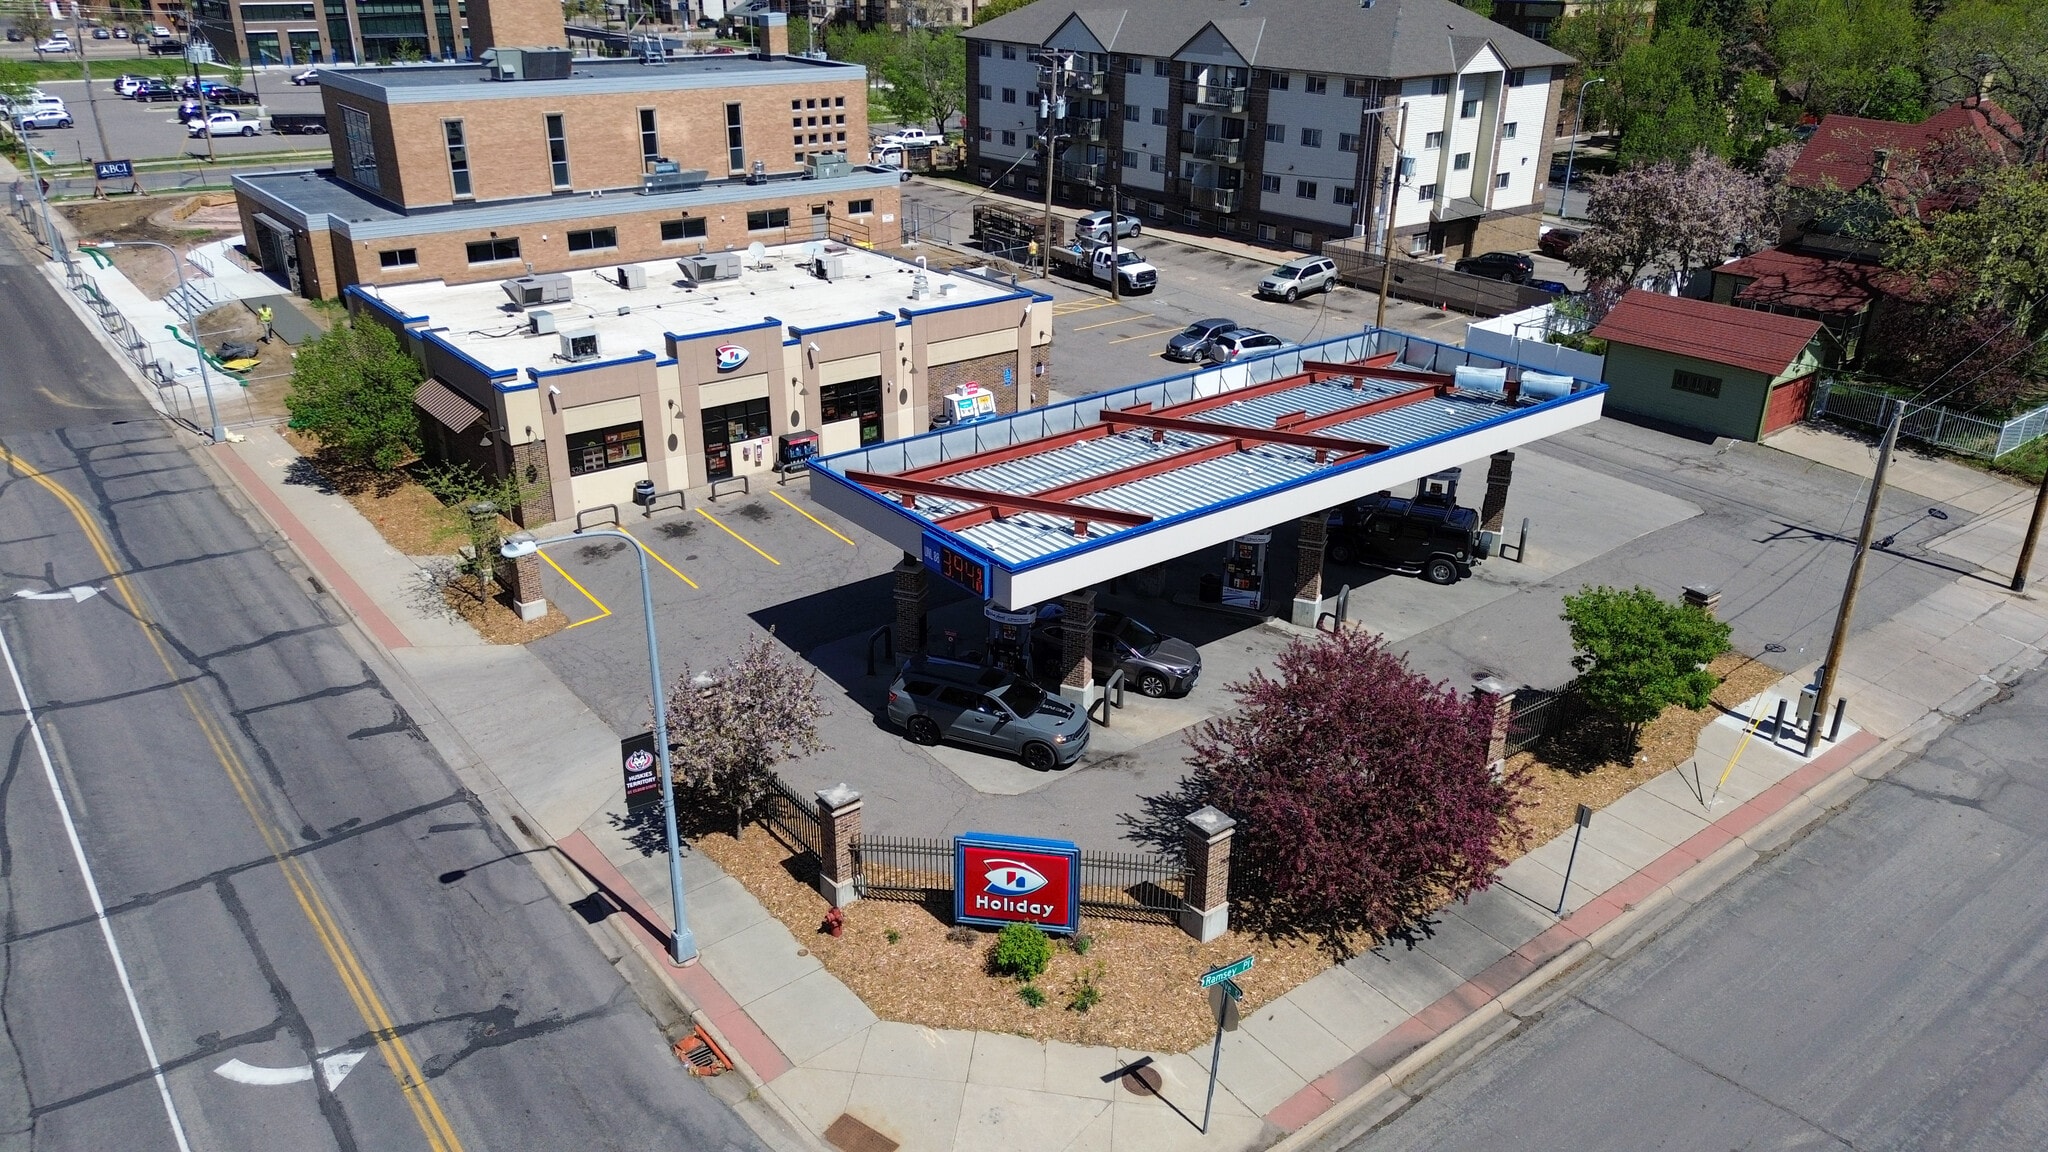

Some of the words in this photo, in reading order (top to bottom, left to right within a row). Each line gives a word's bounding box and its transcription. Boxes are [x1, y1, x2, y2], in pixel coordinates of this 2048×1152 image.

[109, 163, 128, 173] BCI
[626, 776, 656, 789] TERRITORY
[628, 770, 653, 782] HUSKIES
[975, 895, 1054, 918] Holiday
[1205, 967, 1237, 985] Ramsey
[1242, 959, 1251, 970] Pl
